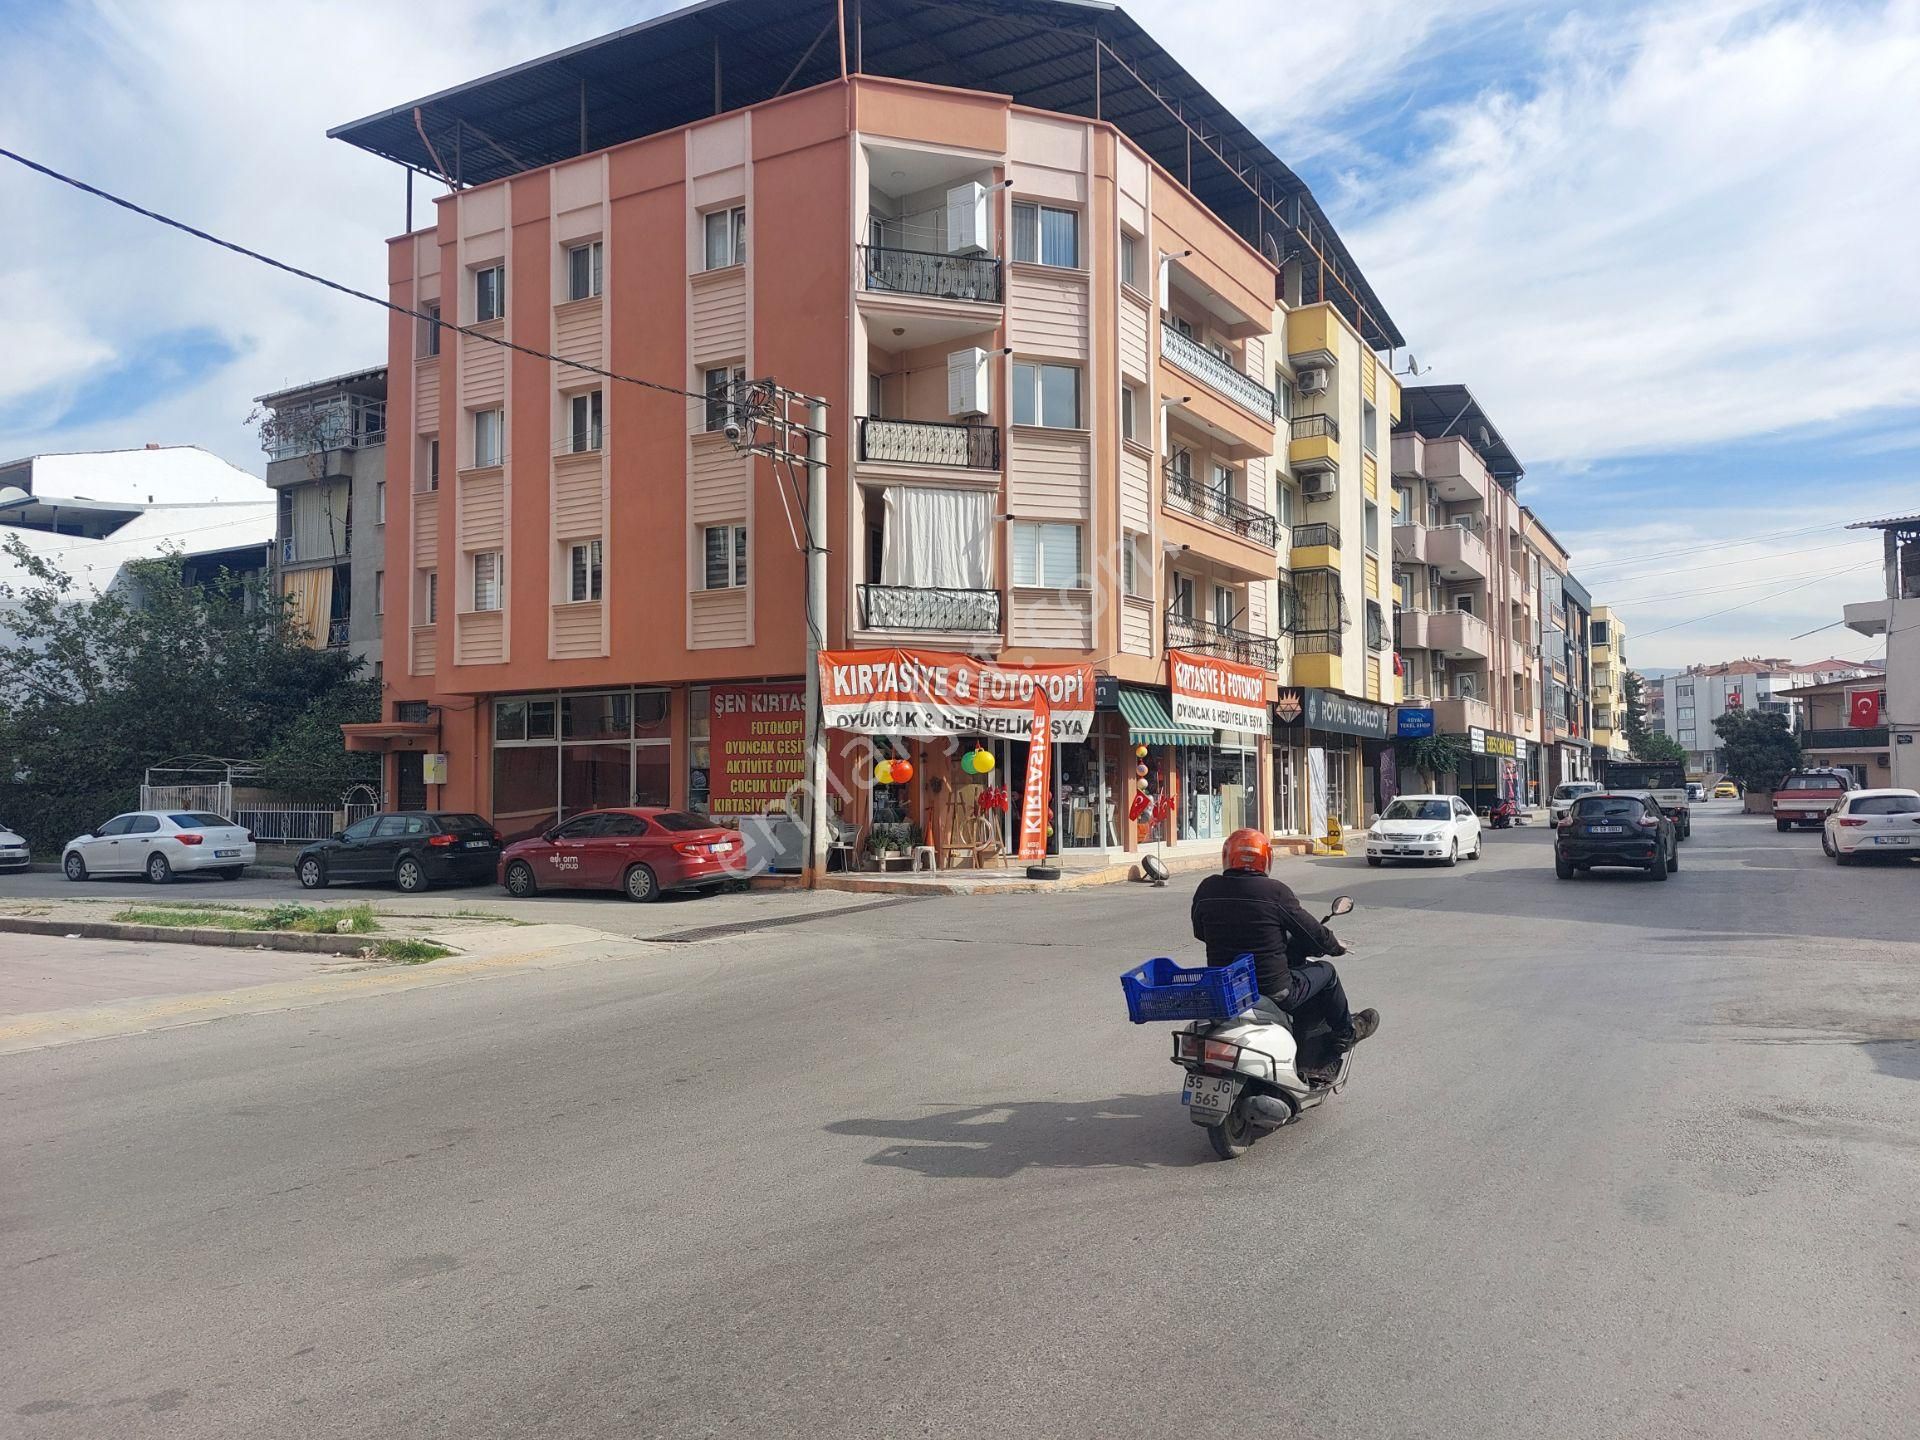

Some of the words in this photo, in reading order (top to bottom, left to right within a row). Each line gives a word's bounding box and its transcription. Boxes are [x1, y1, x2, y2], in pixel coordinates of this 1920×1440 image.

[833, 657, 949, 696] KIRTASİYE
[955, 668, 970, 698] &
[979, 668, 1083, 703] FOTOKOPİ
[1175, 661, 1218, 694] KIRTASİYE
[1220, 671, 1226, 695] &
[1227, 673, 1263, 703] FOTOKOPİ
[714, 694, 746, 718] ŞEN
[1321, 701, 1347, 724] ROYAL
[1347, 704, 1379, 729] TOBACCO
[836, 710, 918, 728] OYUNCAK
[924, 712, 935, 728] &
[942, 714, 1034, 735] HEDİYELİK
[1177, 703, 1211, 721] OYUNCAK
[1217, 709, 1249, 727] HEDİYELİK
[1249, 715, 1263, 731] EŞYA
[751, 719, 803, 735] FOTOKOPİ
[725, 740, 775, 755] OYUNCAK
[726, 757, 773, 774] AKTİVİTE
[730, 779, 766, 795] ÇOCUK
[714, 797, 767, 813] KIRTASİYE
[1187, 1075, 1203, 1089] 35
[1213, 1080, 1230, 1093] JG
[1195, 1092, 1218, 1106] 565
